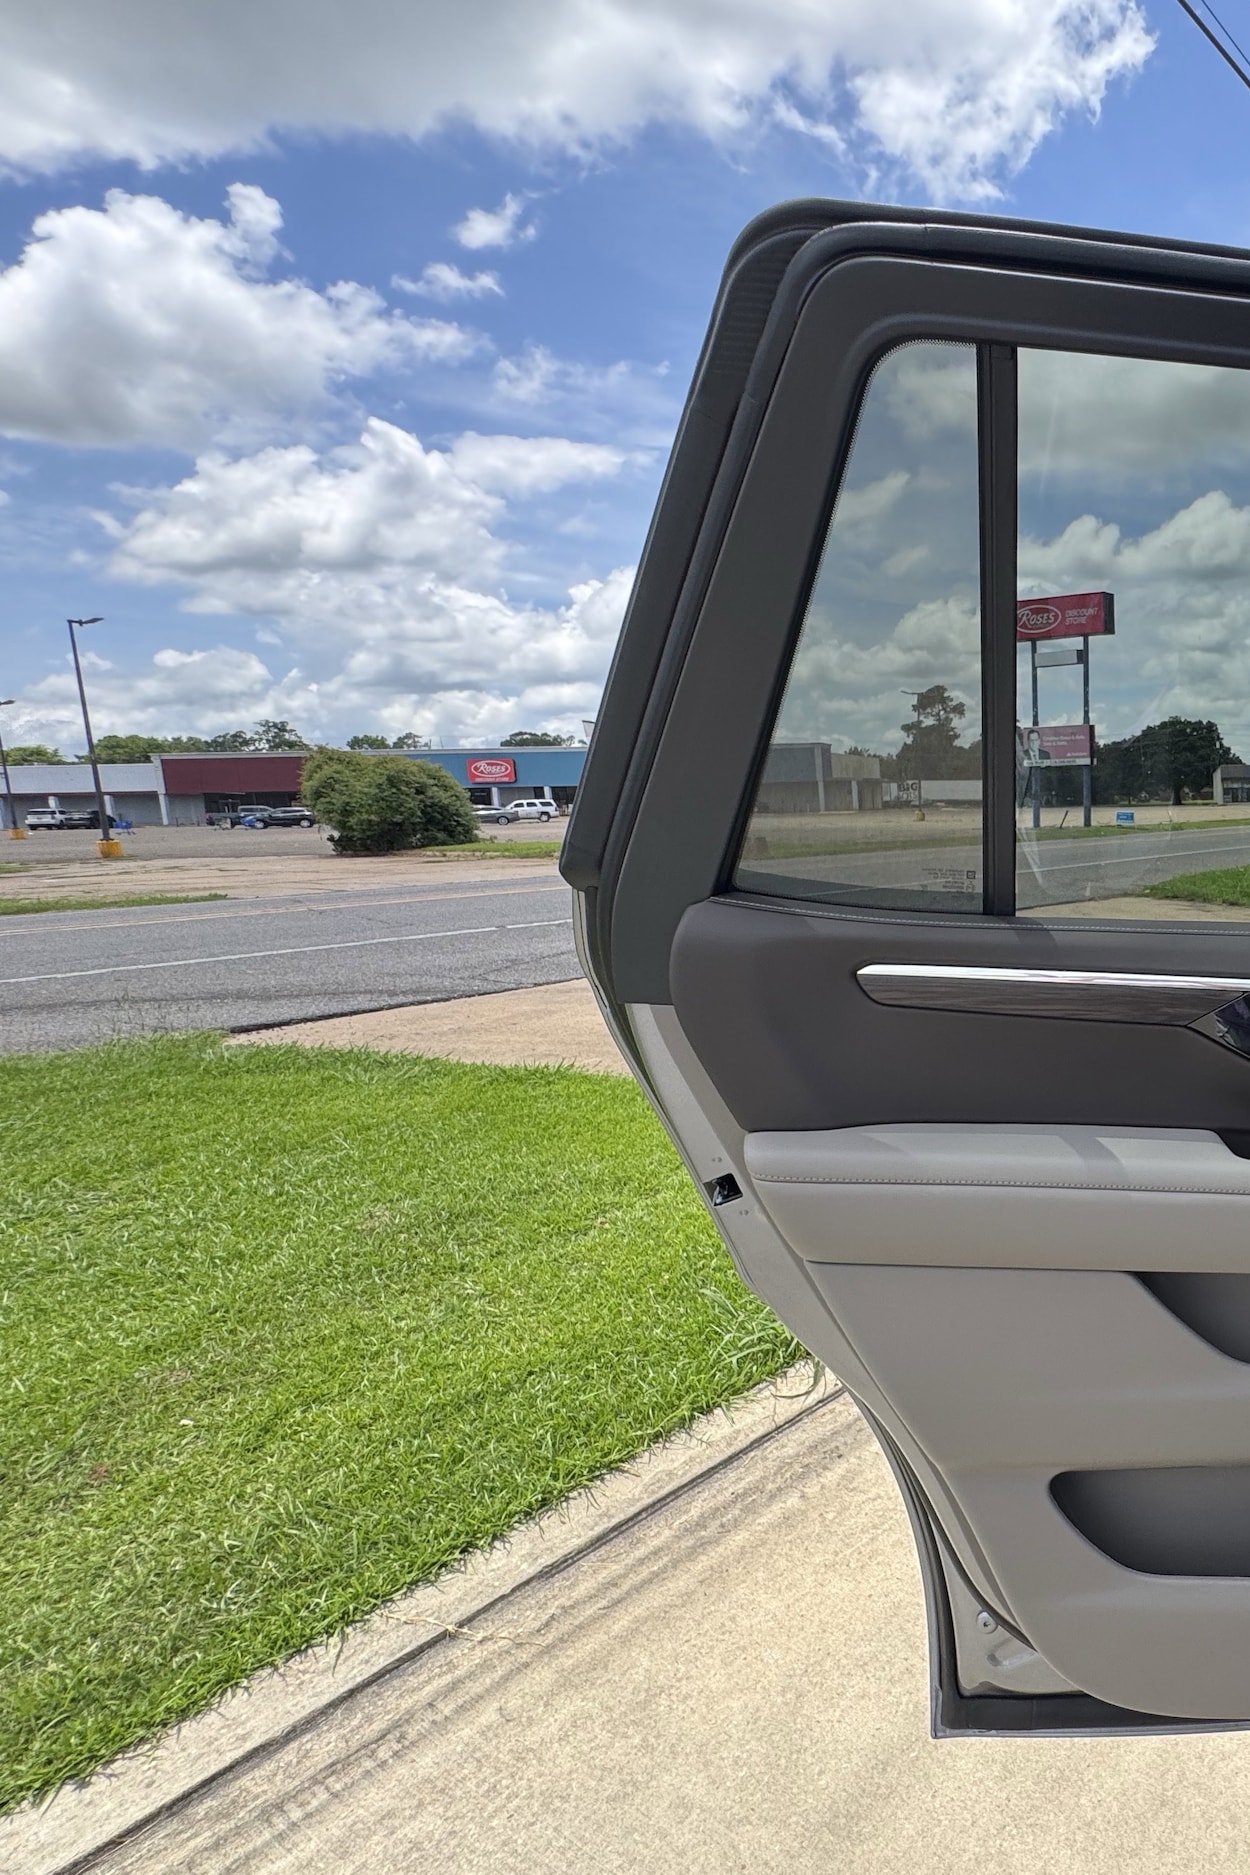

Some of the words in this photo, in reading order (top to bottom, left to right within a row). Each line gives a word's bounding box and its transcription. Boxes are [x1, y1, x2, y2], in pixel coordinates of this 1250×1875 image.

[1065, 607, 1098, 617] DISCOUNT
[1018, 610, 1055, 628] ROSES
[1065, 617, 1087, 625] STORE
[476, 762, 506, 774] ROSES
